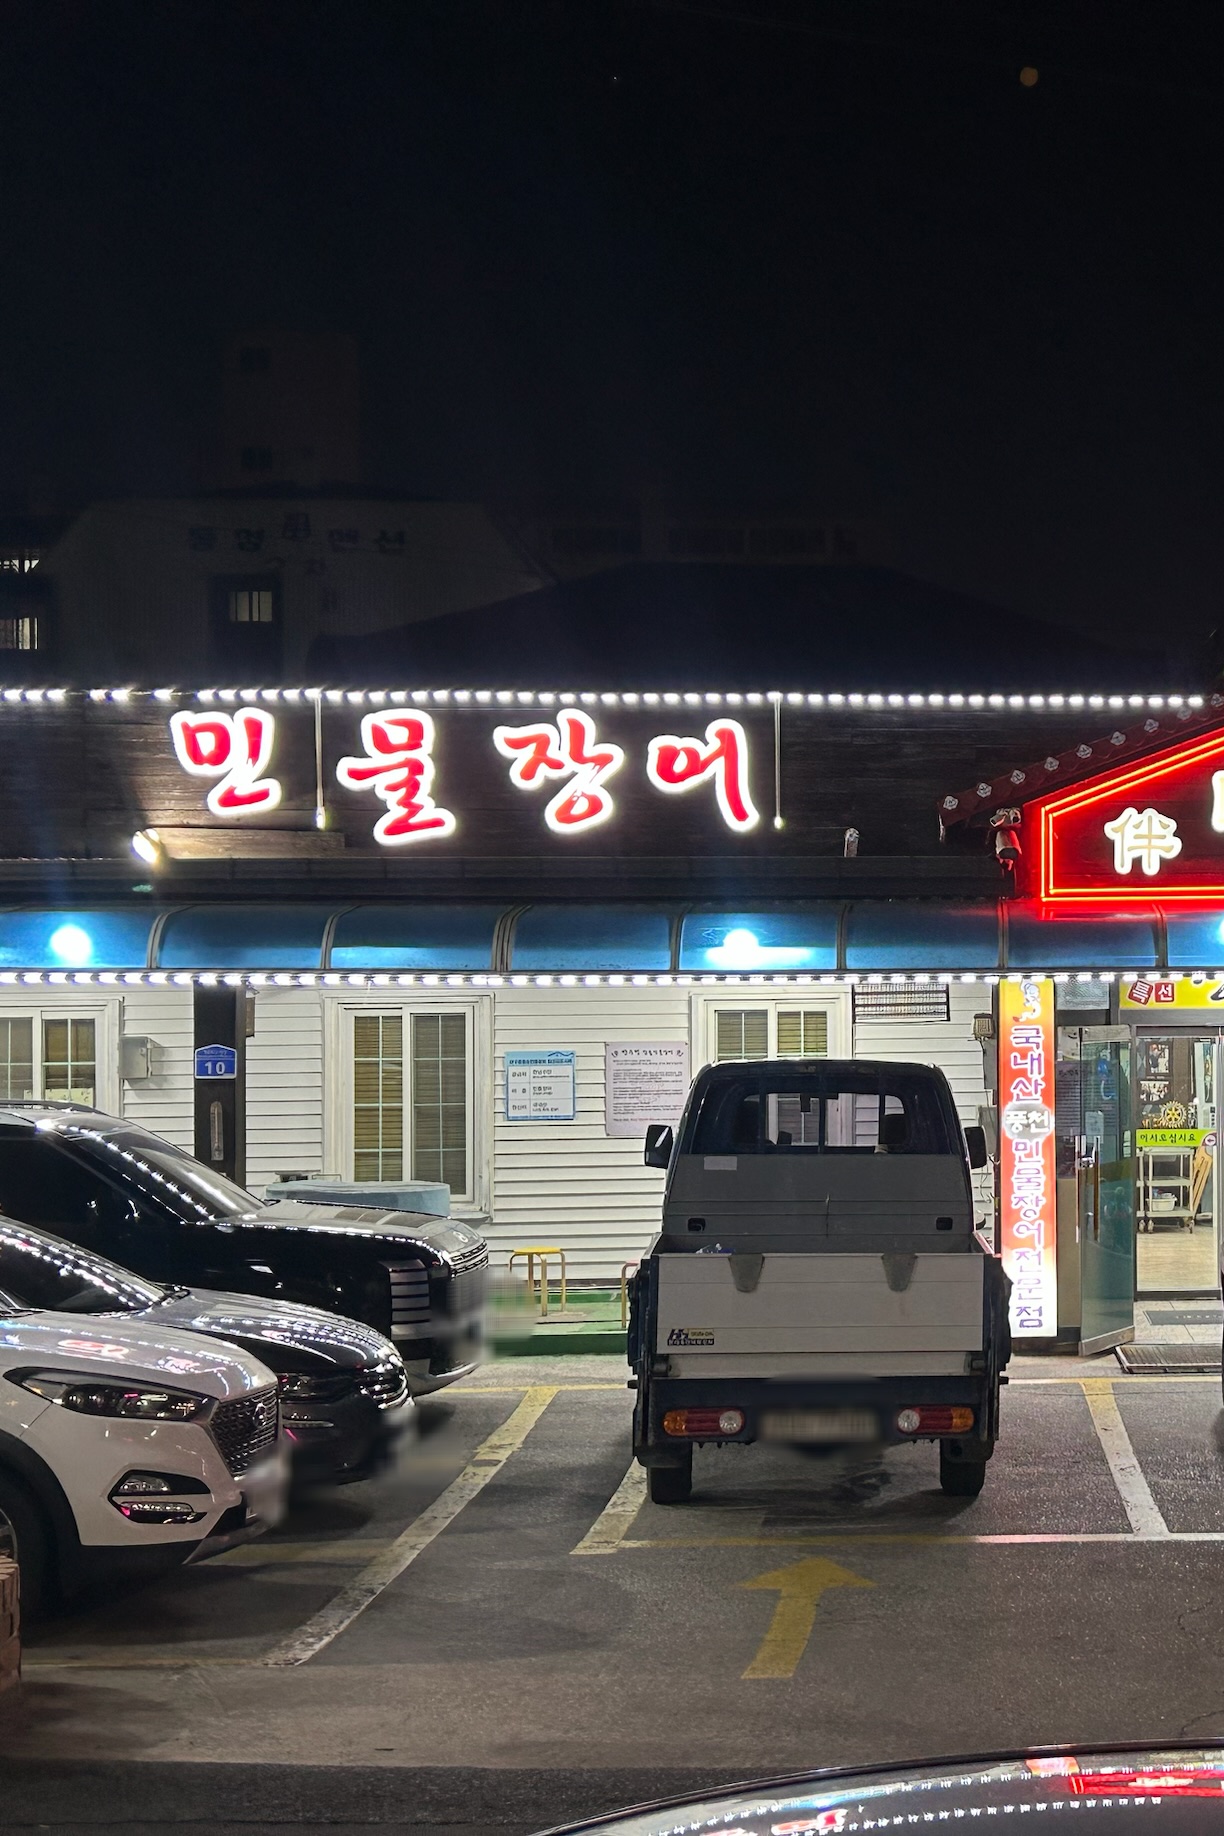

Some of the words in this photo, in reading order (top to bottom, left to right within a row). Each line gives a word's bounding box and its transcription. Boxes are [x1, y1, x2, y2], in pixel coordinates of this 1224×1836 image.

[170, 708, 760, 846] 민물장어
[204, 1061, 225, 1075] 10
[1010, 1026, 1044, 1103] 국내산
[1005, 1110, 1050, 1133] 풍천
